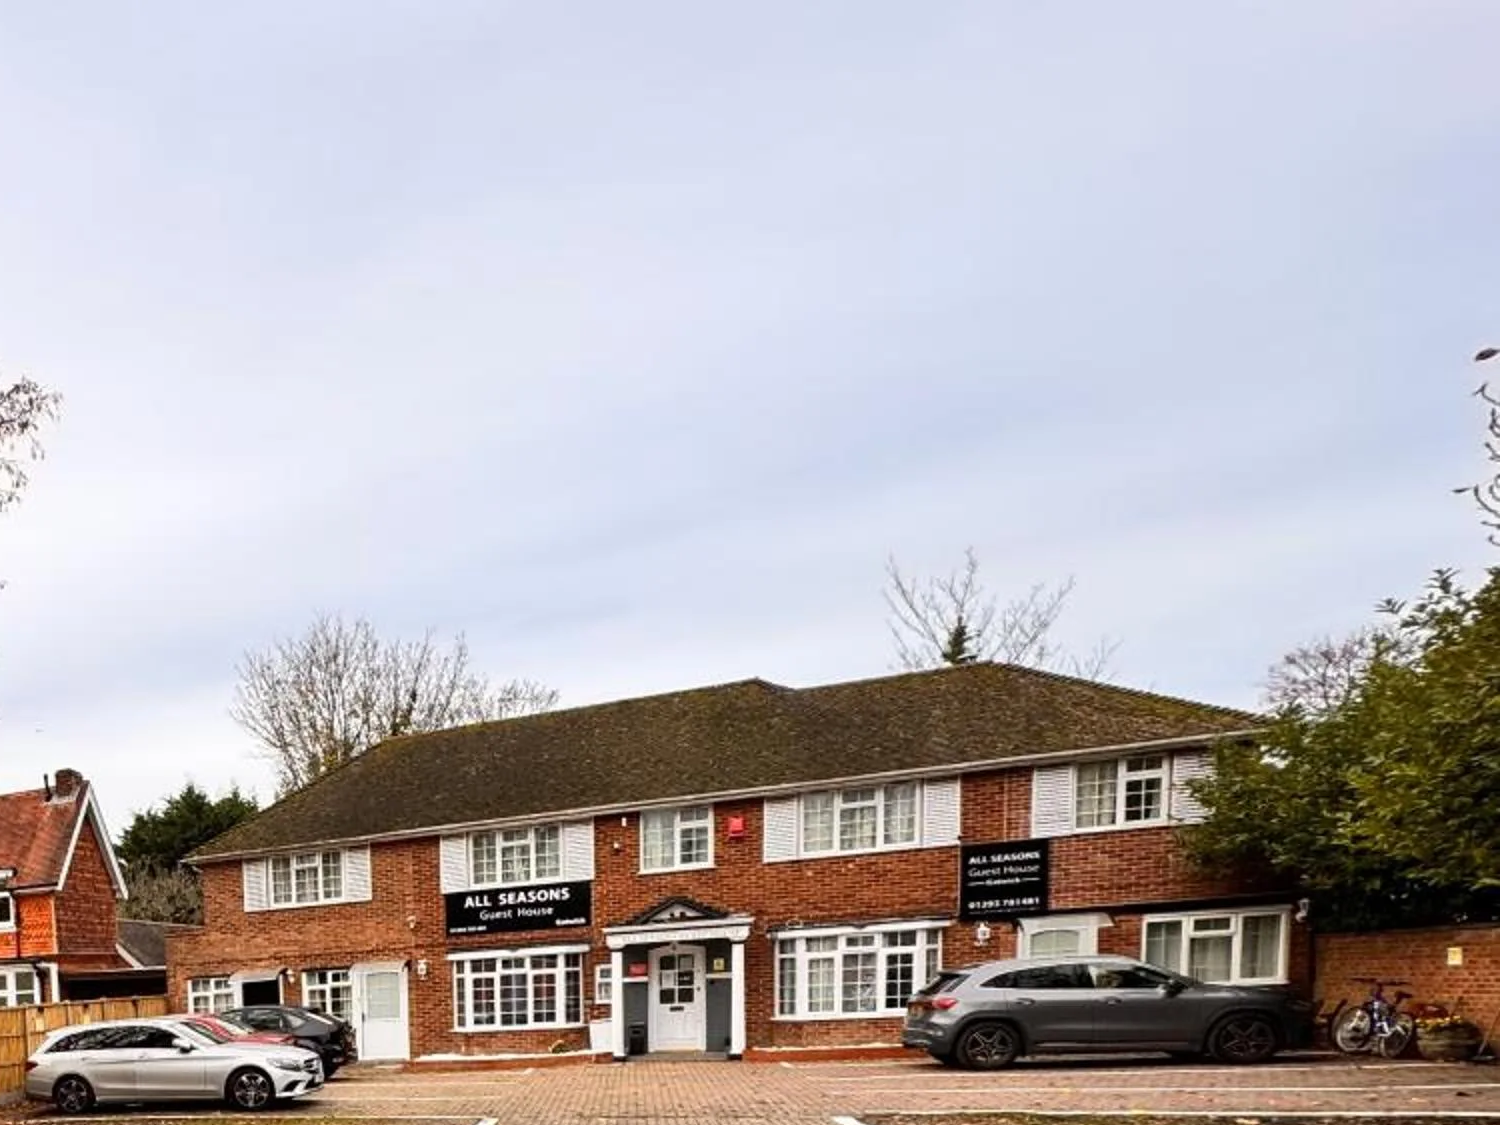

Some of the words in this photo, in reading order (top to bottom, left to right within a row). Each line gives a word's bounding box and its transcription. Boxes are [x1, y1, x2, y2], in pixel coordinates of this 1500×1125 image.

[463, 895, 492, 908] ALL
[498, 887, 570, 906] SEASONS
[479, 908, 514, 921] Guest
[516, 906, 555, 918] House
